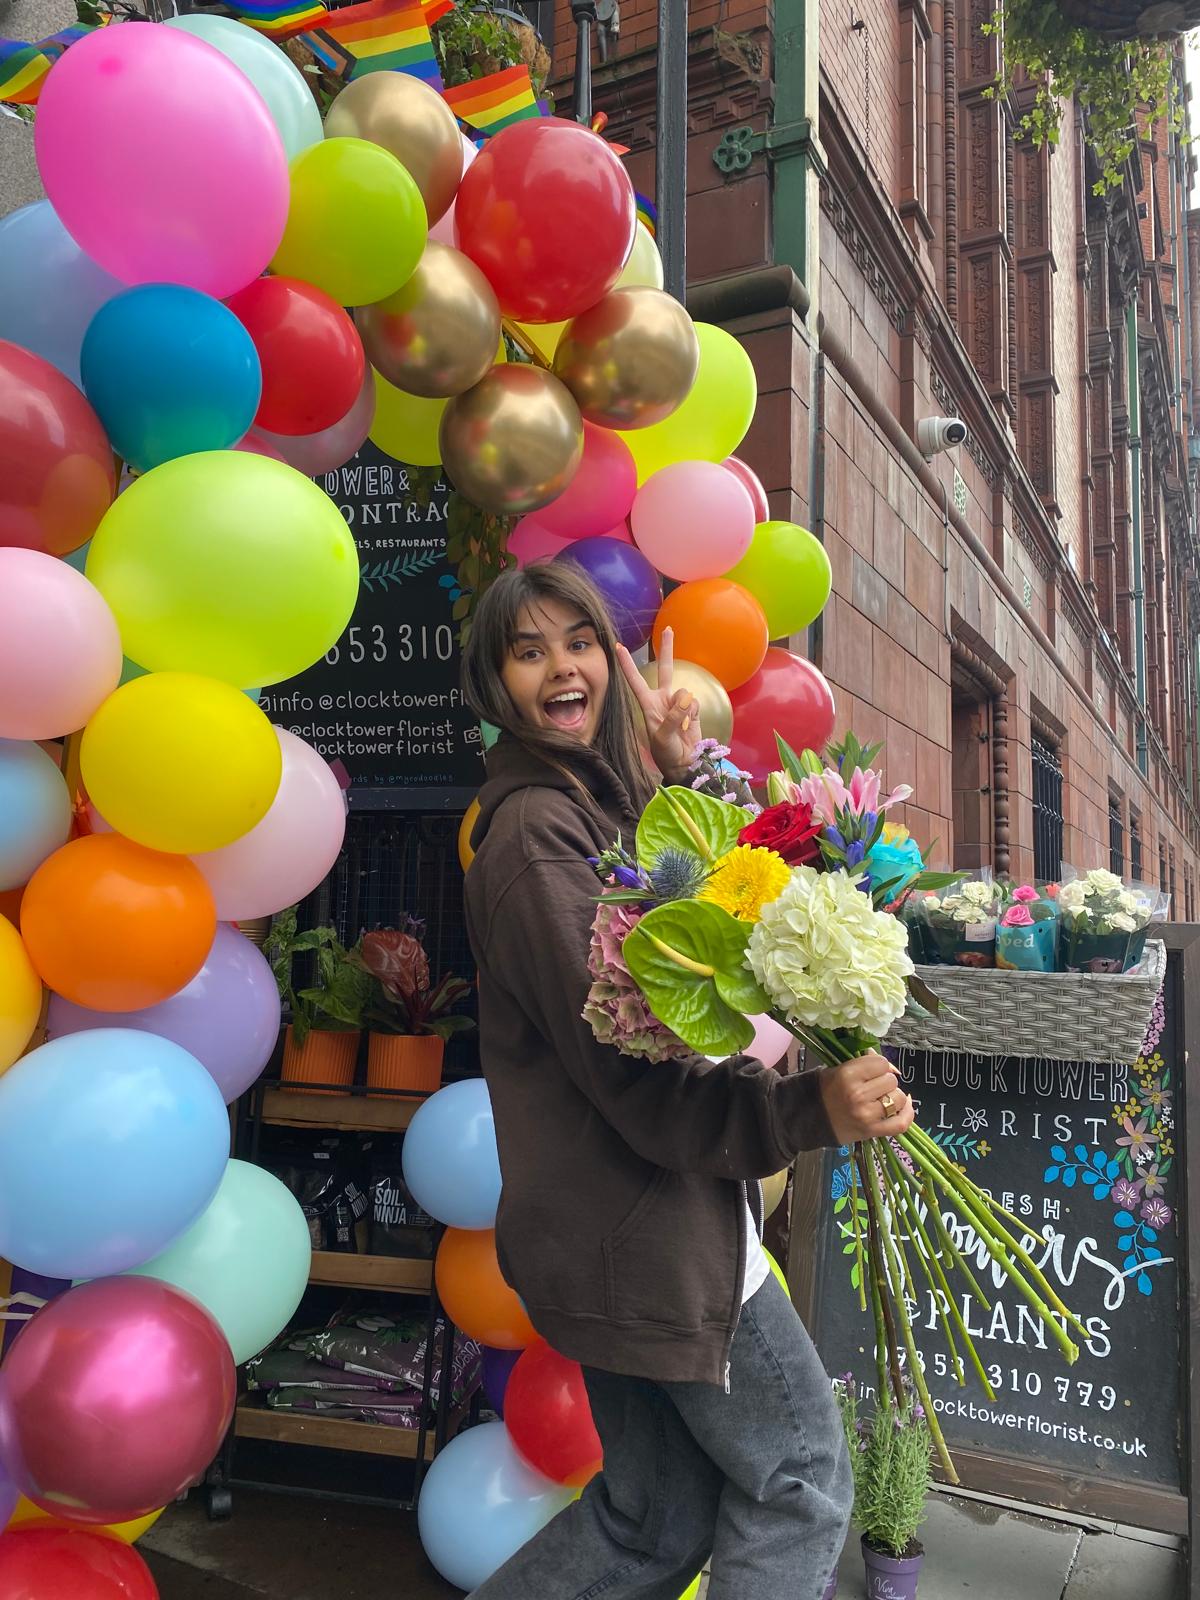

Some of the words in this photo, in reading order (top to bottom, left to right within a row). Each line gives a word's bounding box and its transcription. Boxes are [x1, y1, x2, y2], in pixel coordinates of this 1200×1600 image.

[311, 465, 394, 496] OWER
[339, 502, 448, 525] ONTRA
[375, 538, 447, 549] RESTAURANTS
[398, 624, 453, 660] 310
[319, 688, 467, 711] @clocktowerfl
[313, 739, 455, 756] locktowerflorist
[373, 1204, 407, 1225] NINJA
[958, 1188, 1061, 1221] ESH
[986, 1364, 1043, 1397] 310
[1053, 1375, 1117, 1412] 779
